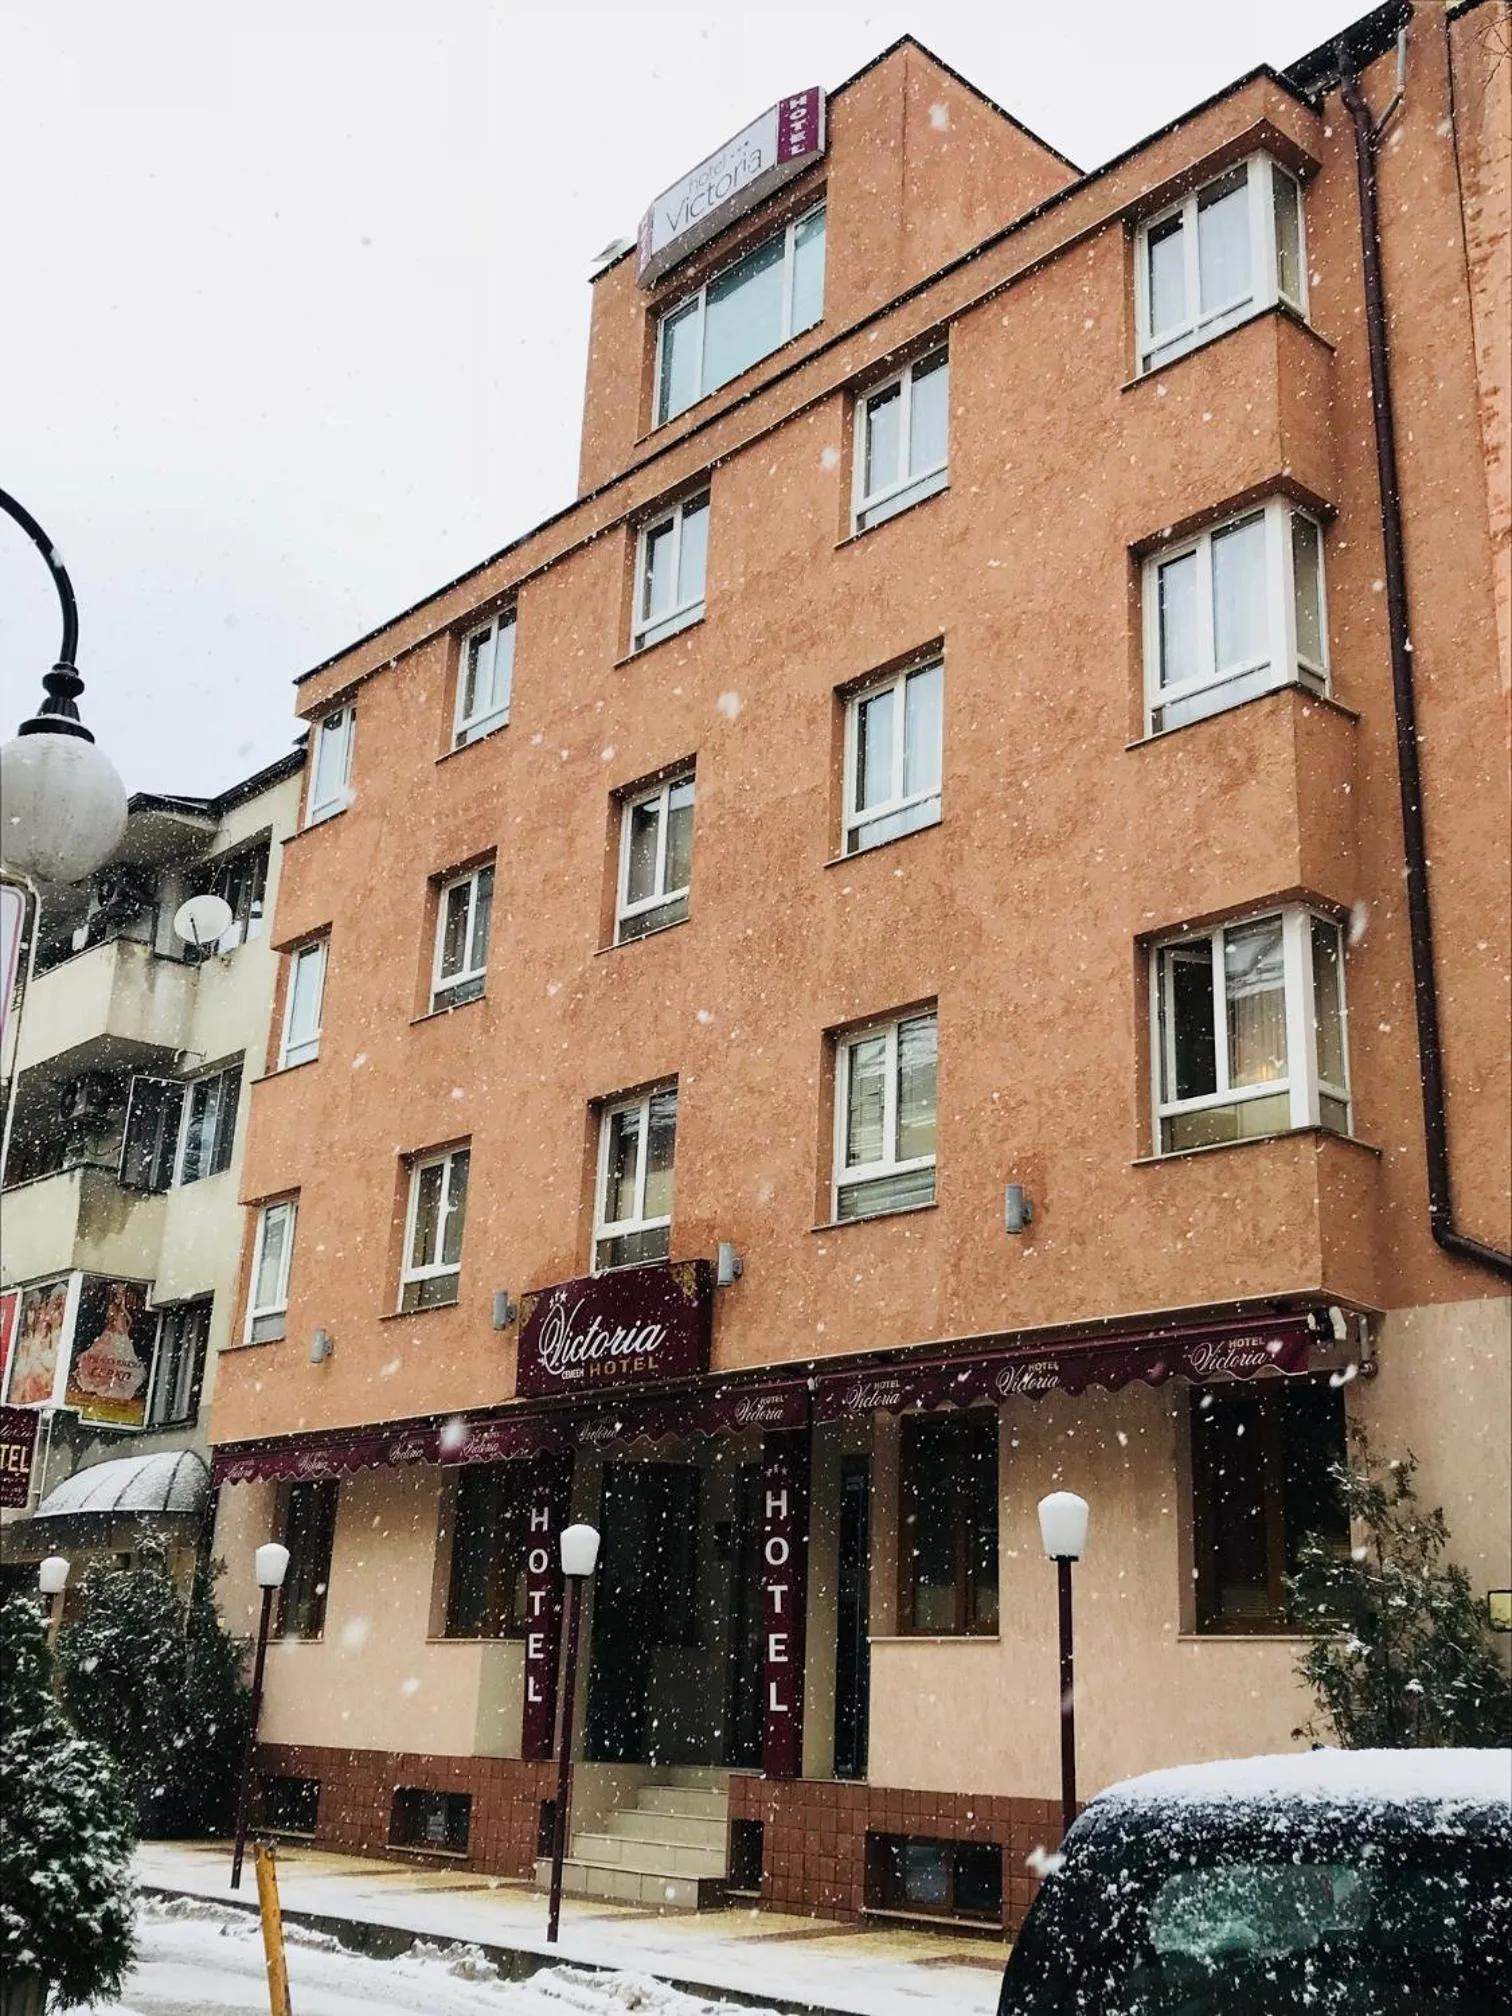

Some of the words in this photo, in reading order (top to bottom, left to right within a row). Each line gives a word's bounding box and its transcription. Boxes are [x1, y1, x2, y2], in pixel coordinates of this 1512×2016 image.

[789, 94, 808, 156] HOTEL
[666, 148, 763, 233] Victoria
[688, 157, 729, 193] hotel
[538, 1298, 667, 1375] Victoria
[1228, 1336, 1266, 1348] HOTEL
[588, 1356, 660, 1378] HOTEL
[1028, 1361, 1060, 1372] HOTEL
[1189, 1342, 1268, 1375] Victoria
[874, 1379, 900, 1389] HOTEL
[995, 1364, 1061, 1396] Victoria
[734, 1398, 783, 1426] Victoria
[847, 1383, 901, 1412] Victoria
[527, 1506, 550, 1703] HOTEL
[764, 1489, 790, 1712] HOTEL
